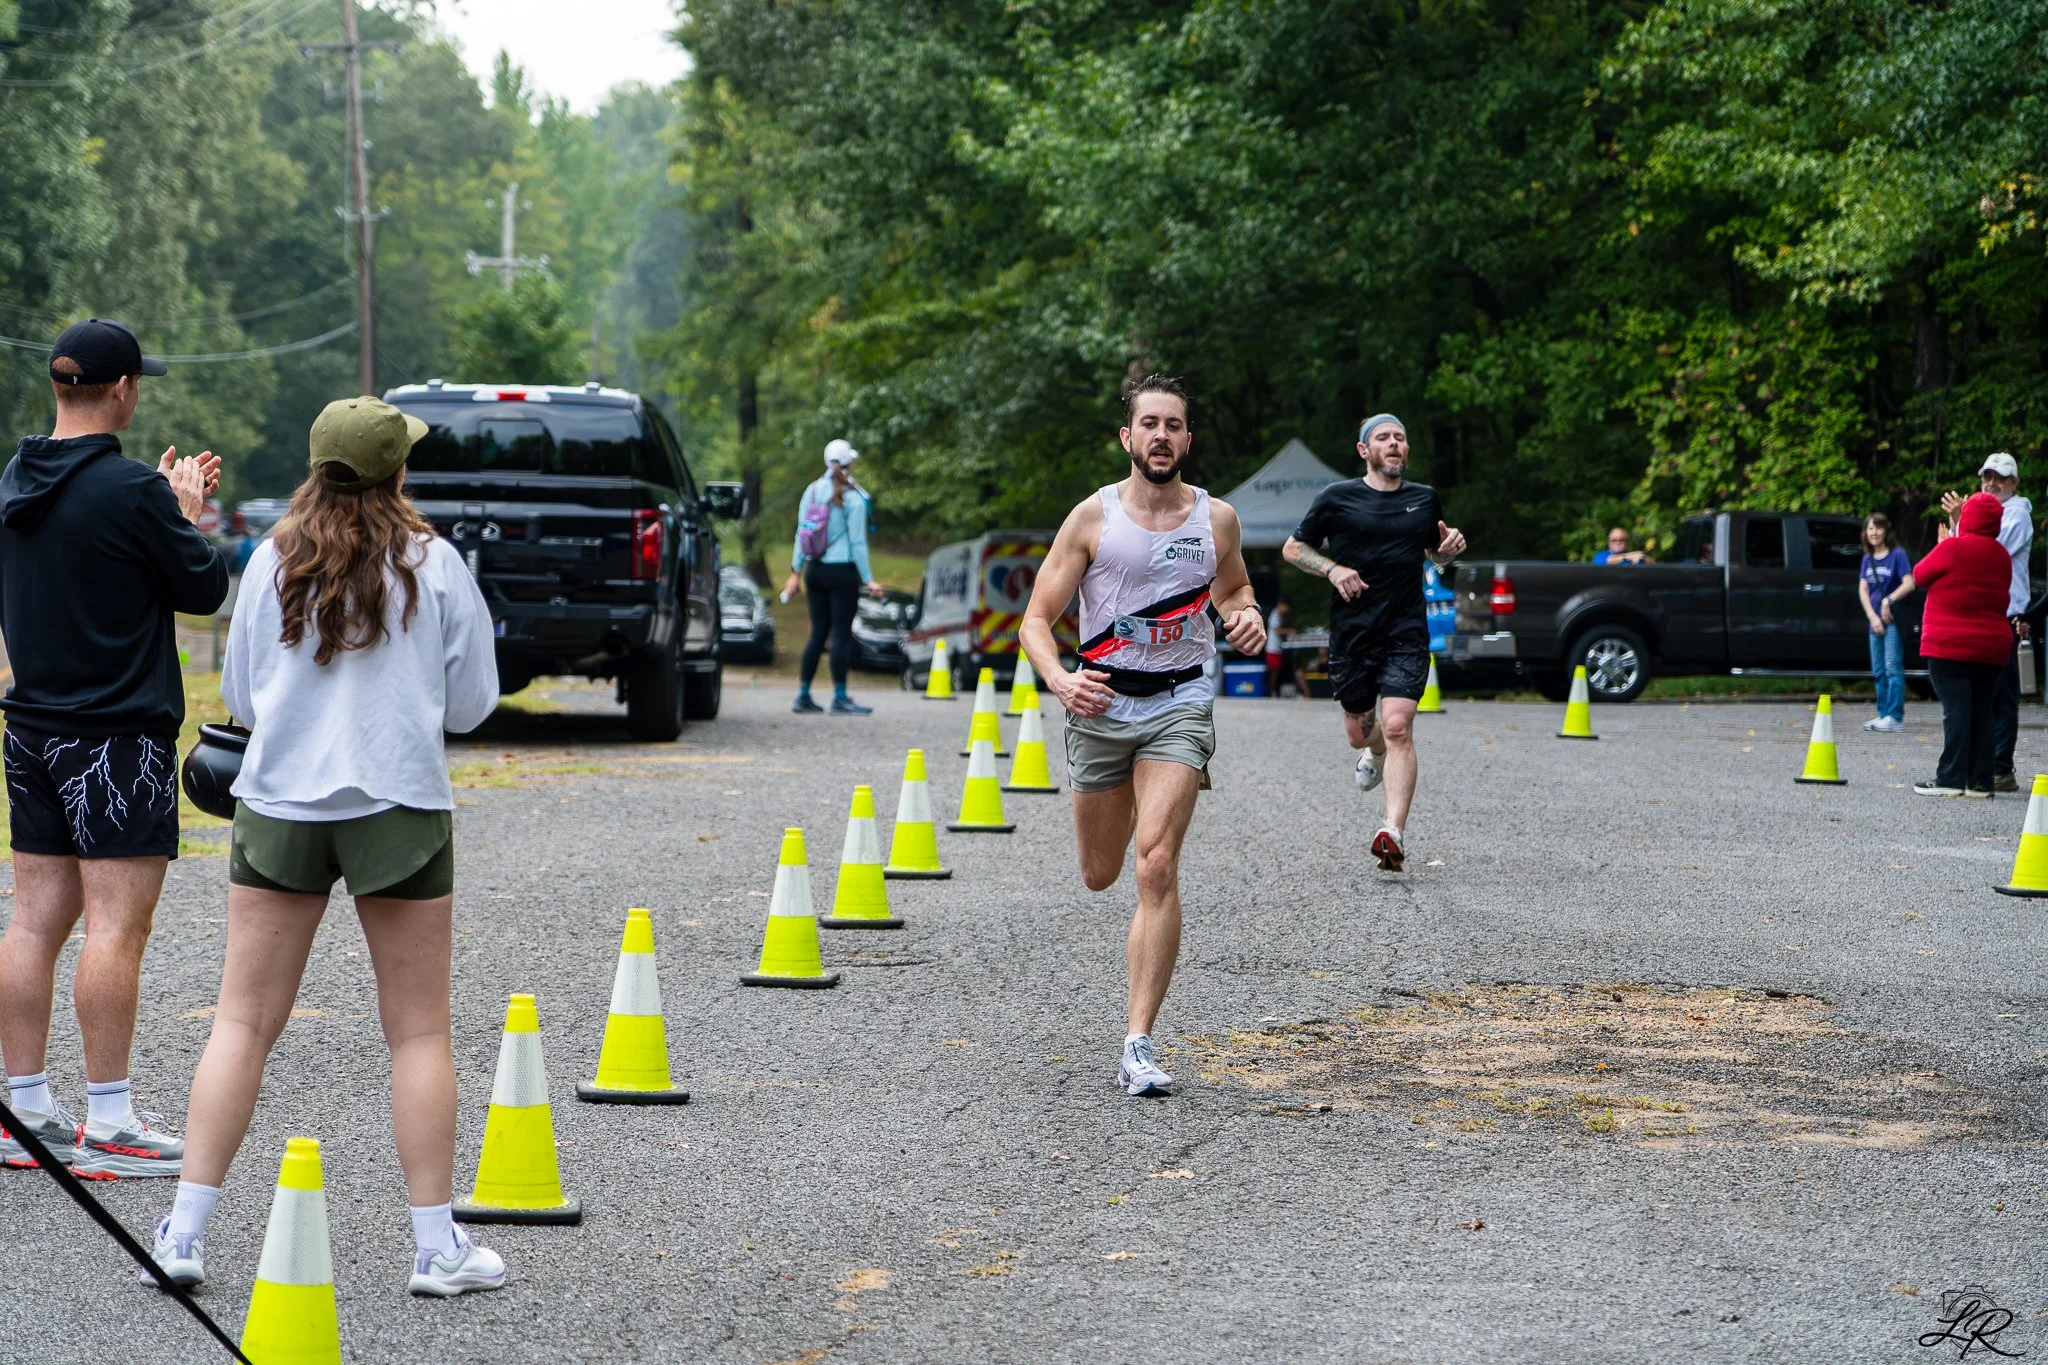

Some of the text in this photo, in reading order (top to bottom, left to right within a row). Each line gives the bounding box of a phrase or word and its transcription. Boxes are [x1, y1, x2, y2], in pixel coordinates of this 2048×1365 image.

[1177, 547, 1205, 562] GRIVET
[1149, 624, 1183, 645] 150
[92, 1143, 161, 1159] ALTRA
